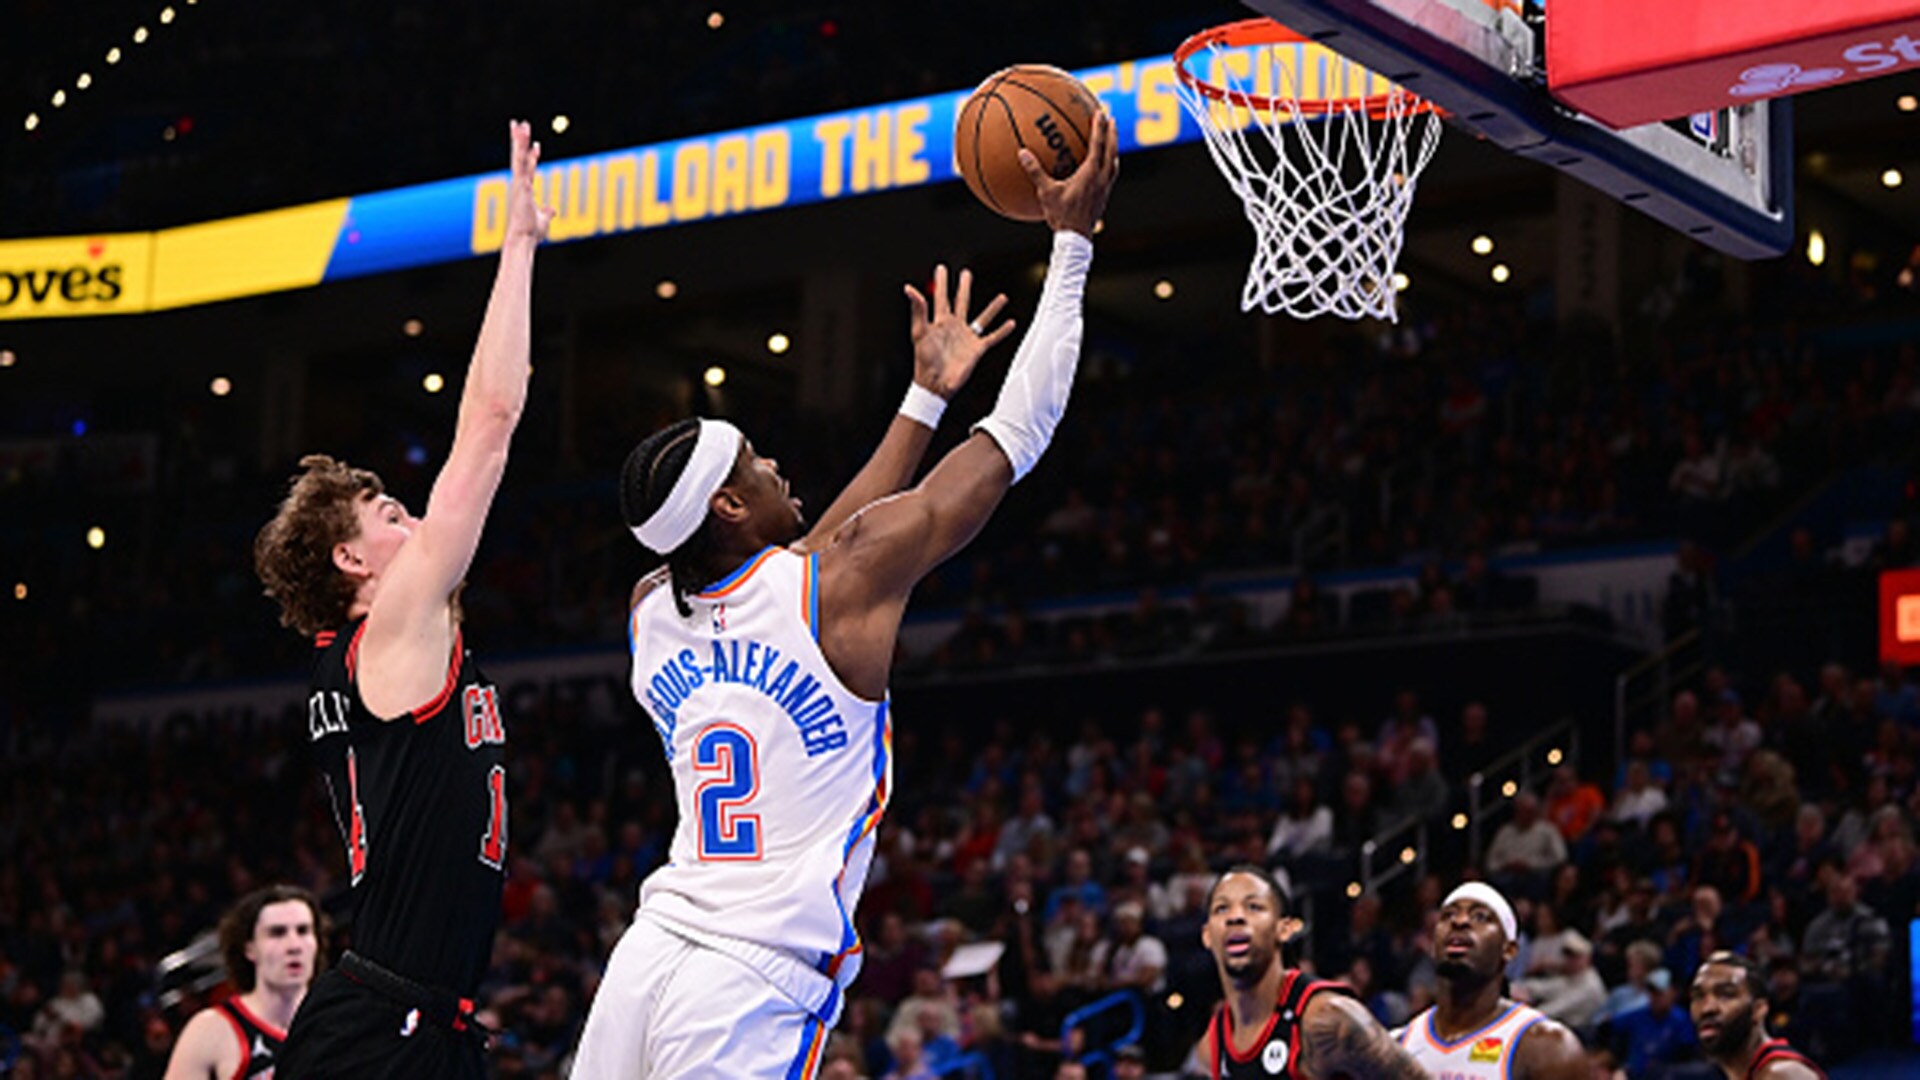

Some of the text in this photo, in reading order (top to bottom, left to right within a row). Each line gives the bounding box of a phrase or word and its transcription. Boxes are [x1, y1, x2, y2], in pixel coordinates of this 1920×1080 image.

[1842, 34, 1920, 73] St
[471, 128, 790, 255] DWNLOAD
[813, 103, 930, 198] THE
[692, 721, 763, 862] 2
